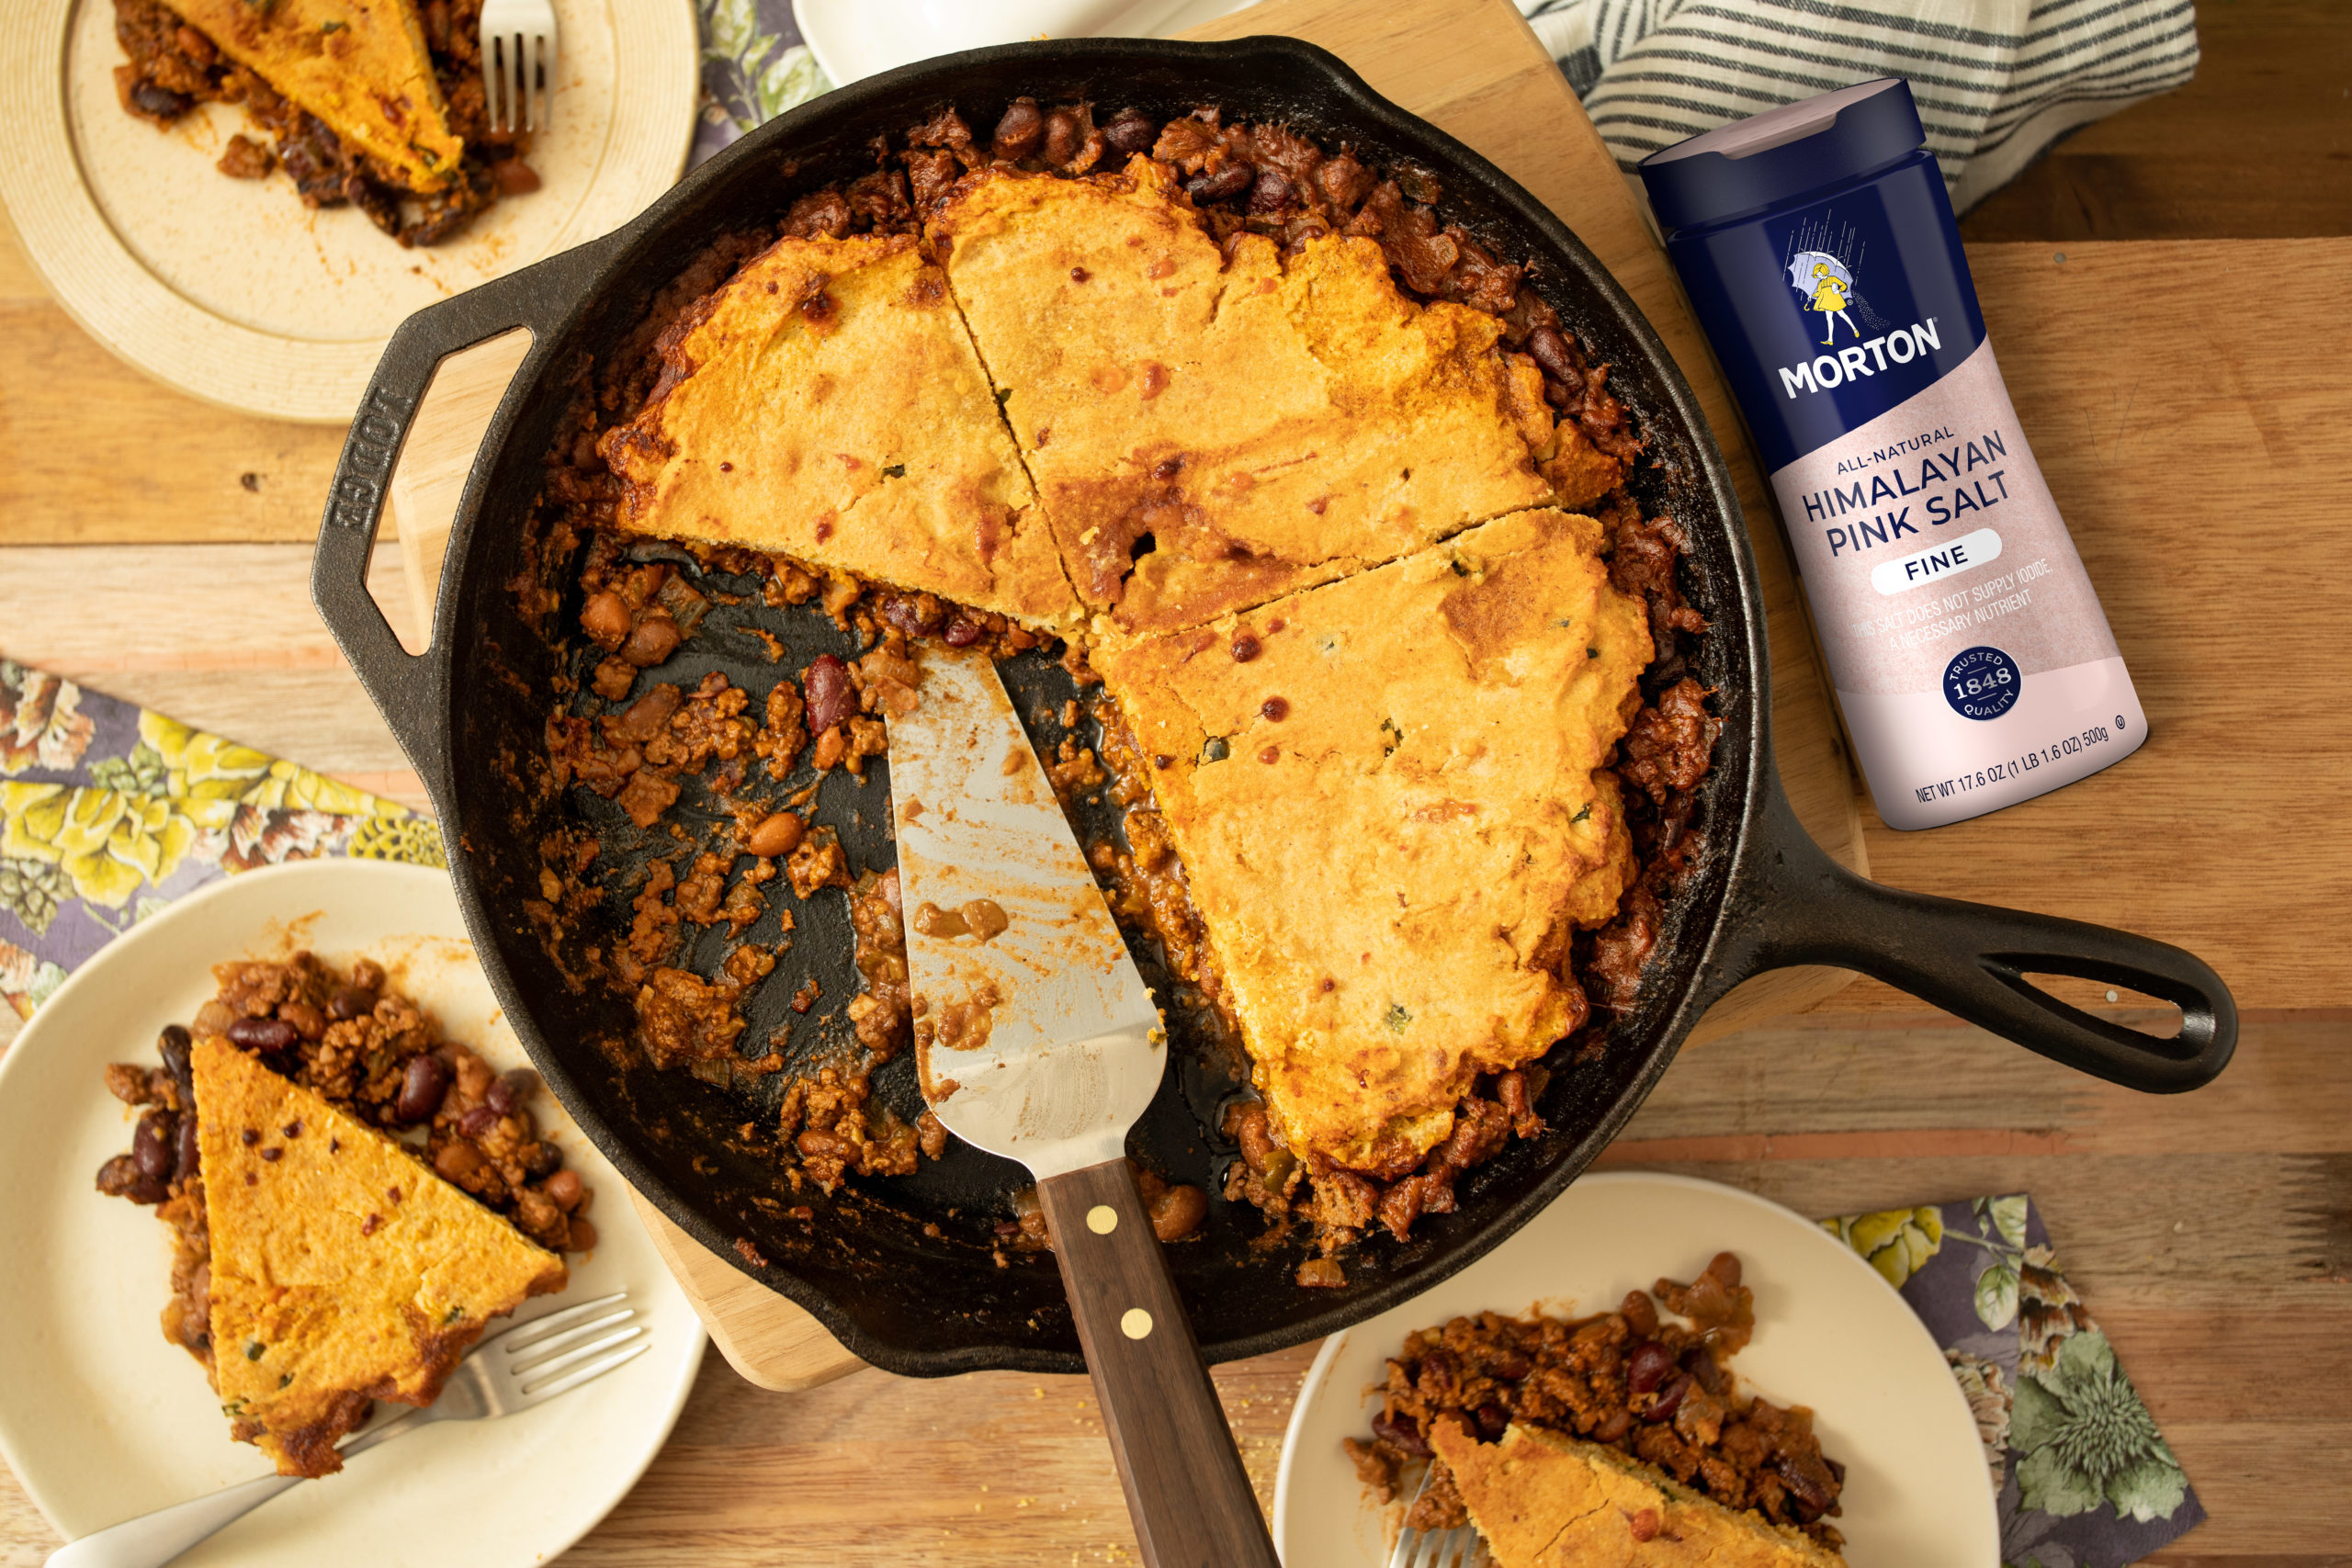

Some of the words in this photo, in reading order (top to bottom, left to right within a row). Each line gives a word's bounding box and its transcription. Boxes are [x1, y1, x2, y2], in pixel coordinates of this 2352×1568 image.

[1779, 318, 1940, 399] MORTON
[329, 386, 413, 533] LODGE
[1803, 430, 2007, 522] HIMALAYAN
[1838, 426, 1954, 475] ALL-NATURAL
[1826, 507, 1919, 557] PINK
[1926, 470, 2008, 525] SALT
[1905, 545, 1968, 581] FINE
[1852, 622, 1875, 638] THIS
[1877, 612, 1905, 631] SALT
[1906, 603, 1941, 625] DOES
[1943, 591, 1970, 612] NOT
[1973, 572, 2015, 602] SUPPLY
[2016, 558, 2053, 585] IODIDE,
[1890, 637, 1899, 651] A
[1899, 613, 1973, 649] NECESSARY
[1974, 589, 2032, 624] NUTRIENT
[1950, 652, 2003, 682] TRUSTED
[1953, 667, 2012, 700] 1848
[1964, 689, 2014, 716] QUALITY
[1916, 785, 1936, 804] NET
[1937, 780, 1956, 798] WT
[1958, 772, 1985, 793] 17.6
[1987, 764, 2006, 783] OZ
[2007, 760, 2019, 778] (1
[2021, 752, 2040, 772] LB
[2041, 744, 2062, 763] 1.6
[2062, 736, 2083, 755] OZ)
[2082, 727, 2109, 747] 500g
